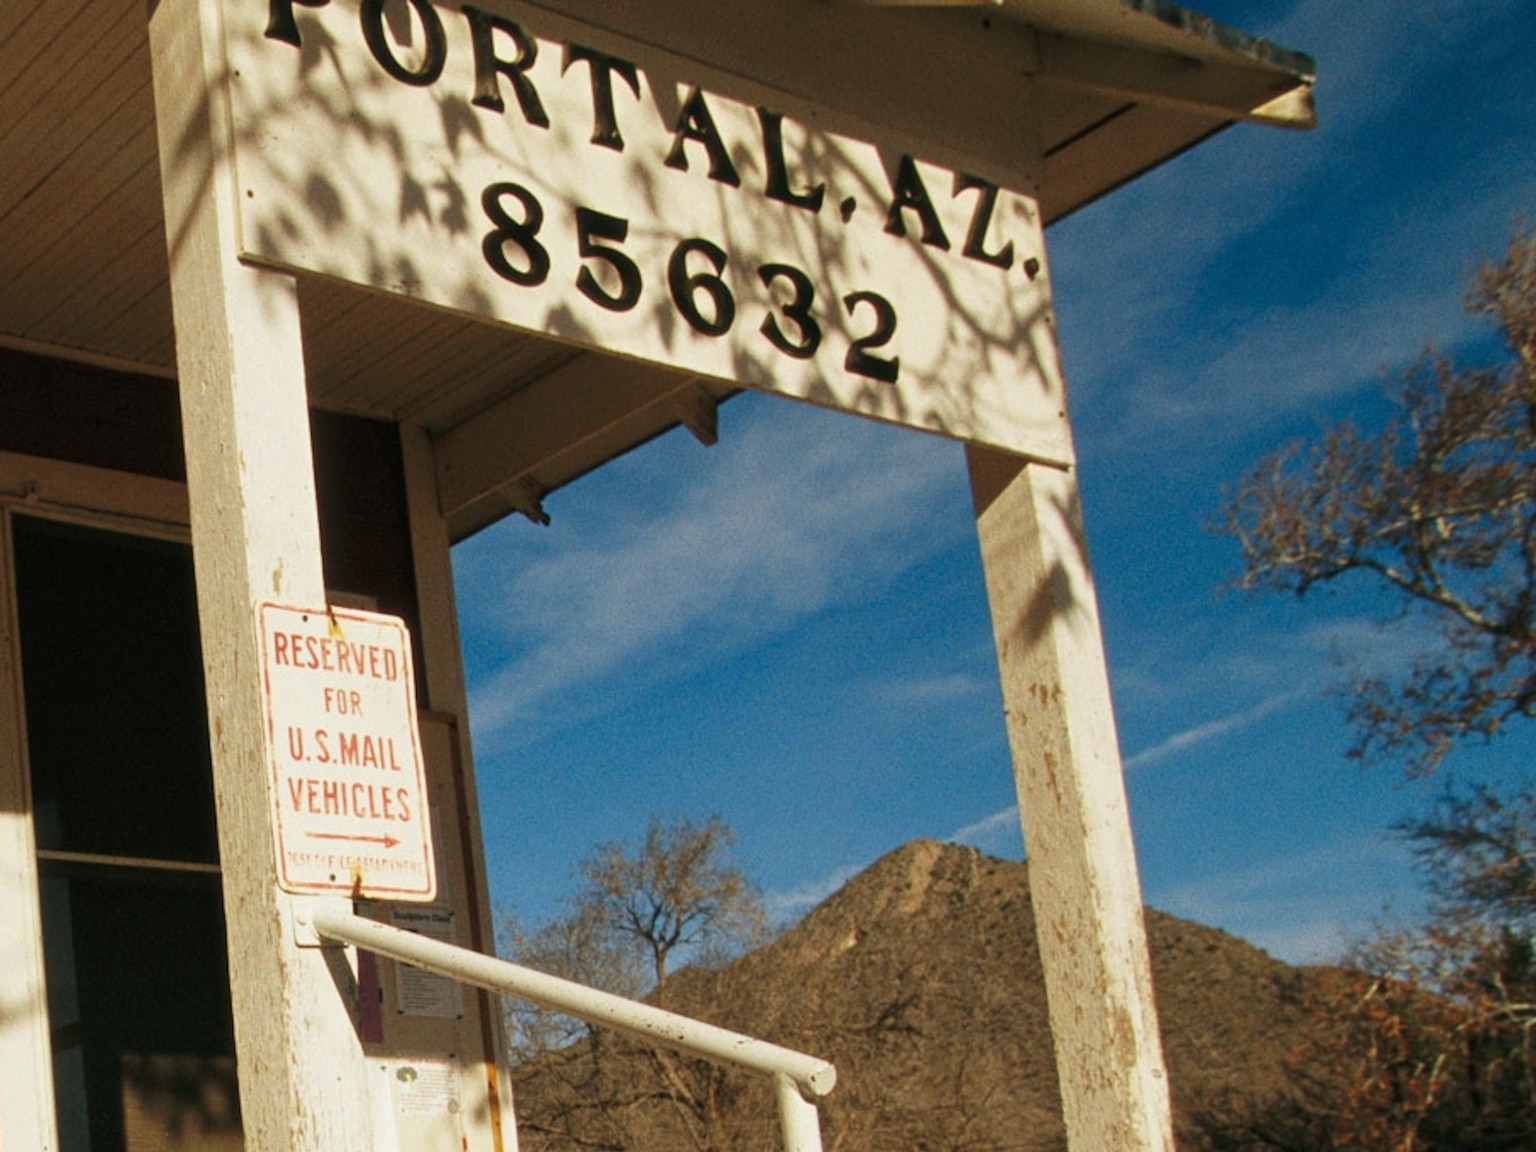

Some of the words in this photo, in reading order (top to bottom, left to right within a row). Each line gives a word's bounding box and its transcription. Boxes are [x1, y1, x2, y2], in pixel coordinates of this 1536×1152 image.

[481, 182, 900, 384] 85632
[273, 631, 398, 682] RESERVED
[323, 687, 363, 717] FOR
[286, 776, 411, 823] VEHICLES
